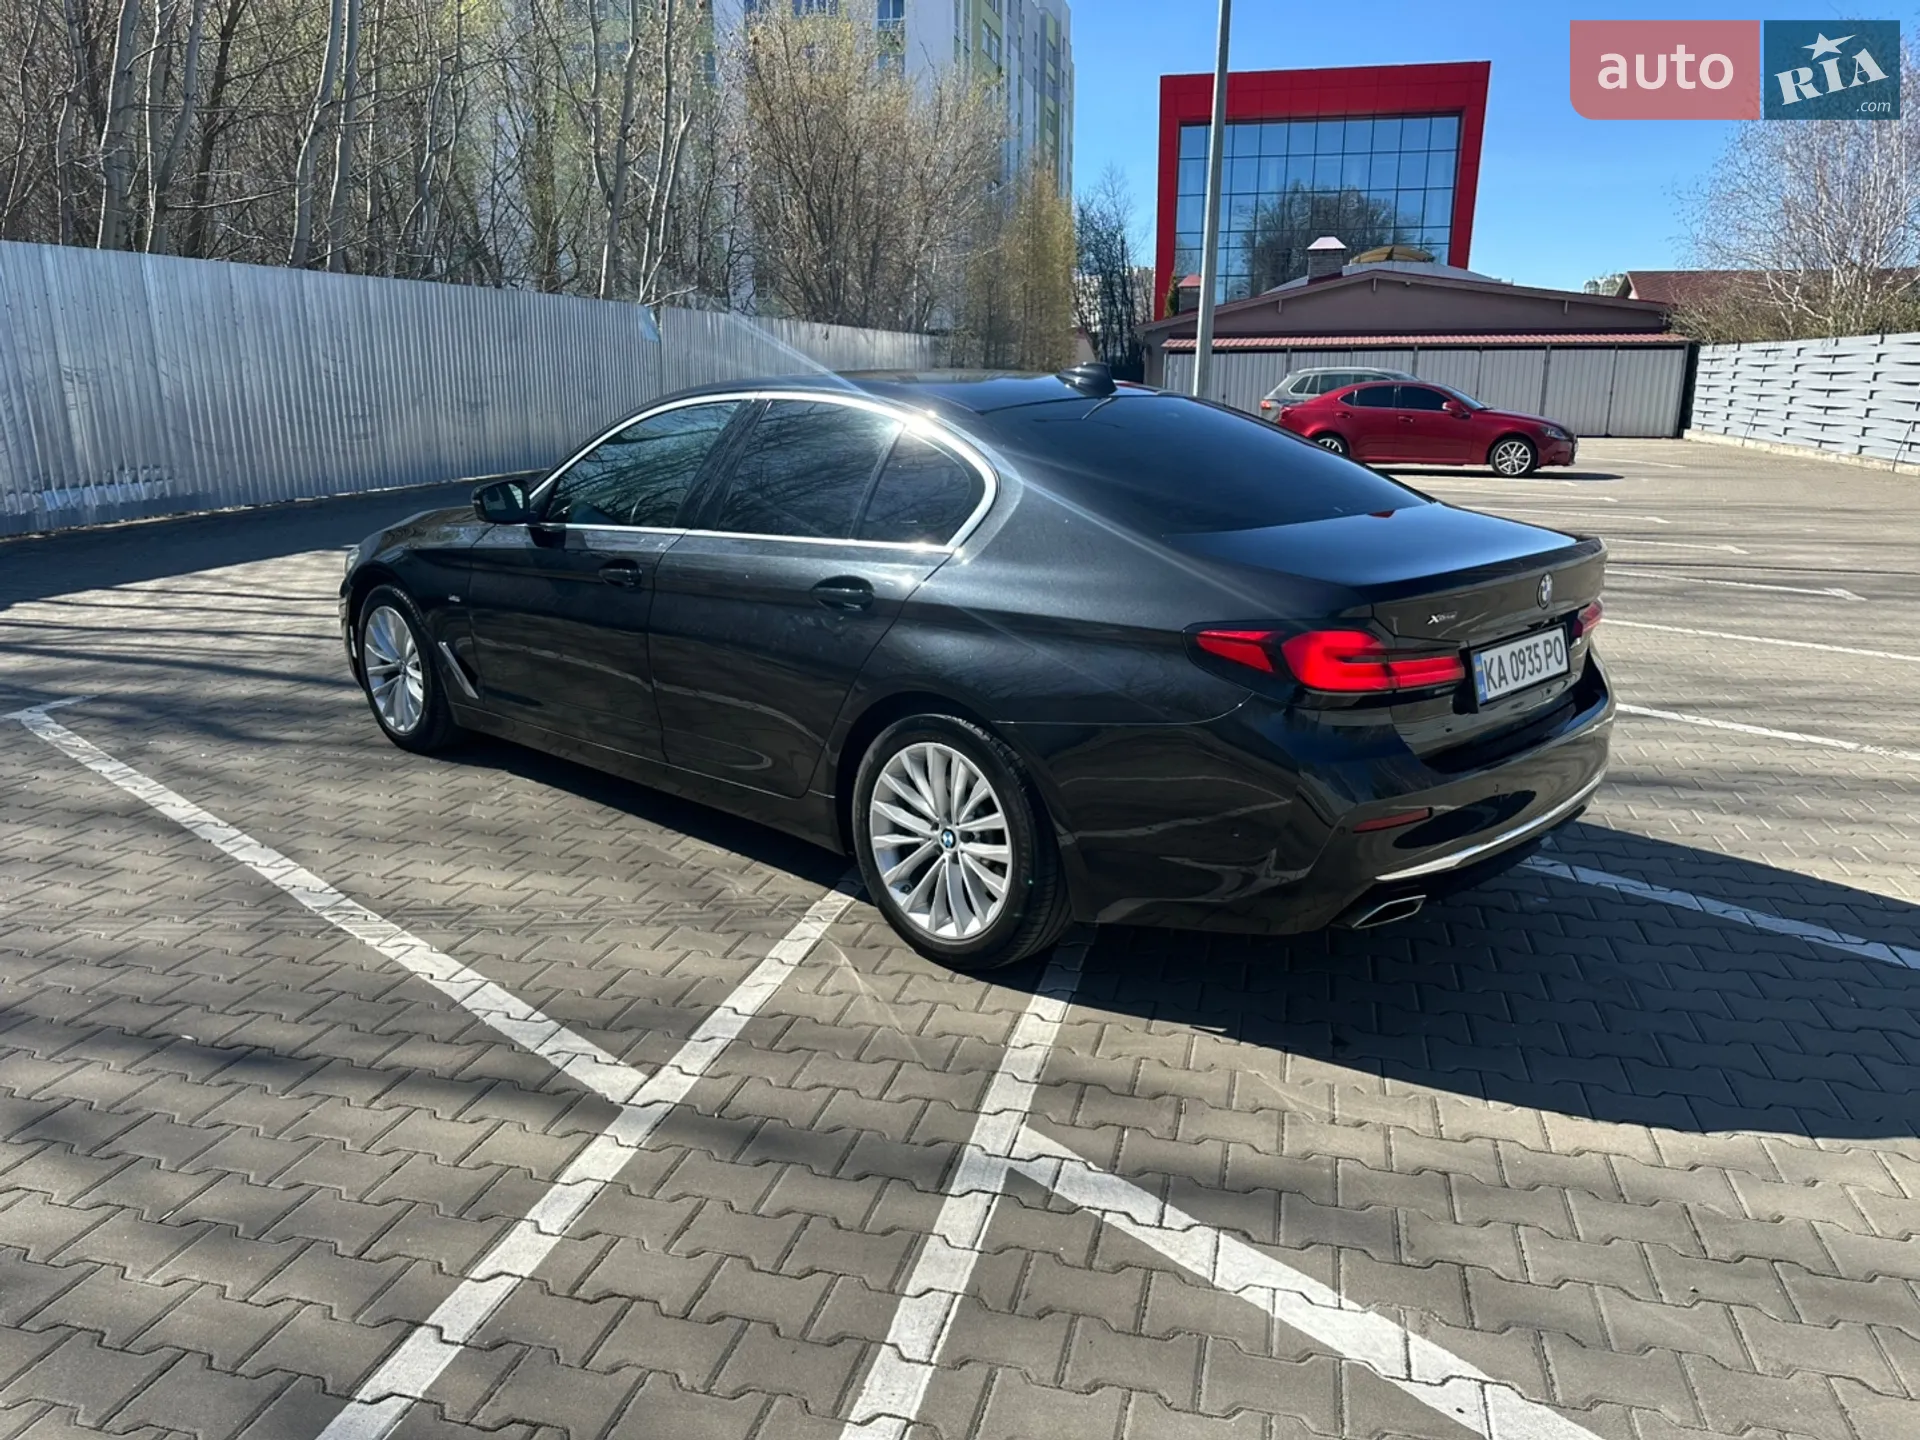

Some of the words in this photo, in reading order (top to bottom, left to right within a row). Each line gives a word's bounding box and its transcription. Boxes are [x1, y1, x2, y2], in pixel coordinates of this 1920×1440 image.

[1484, 655, 1509, 692] KA
[1510, 642, 1542, 682] 0935
[1543, 636, 1564, 670] PO
